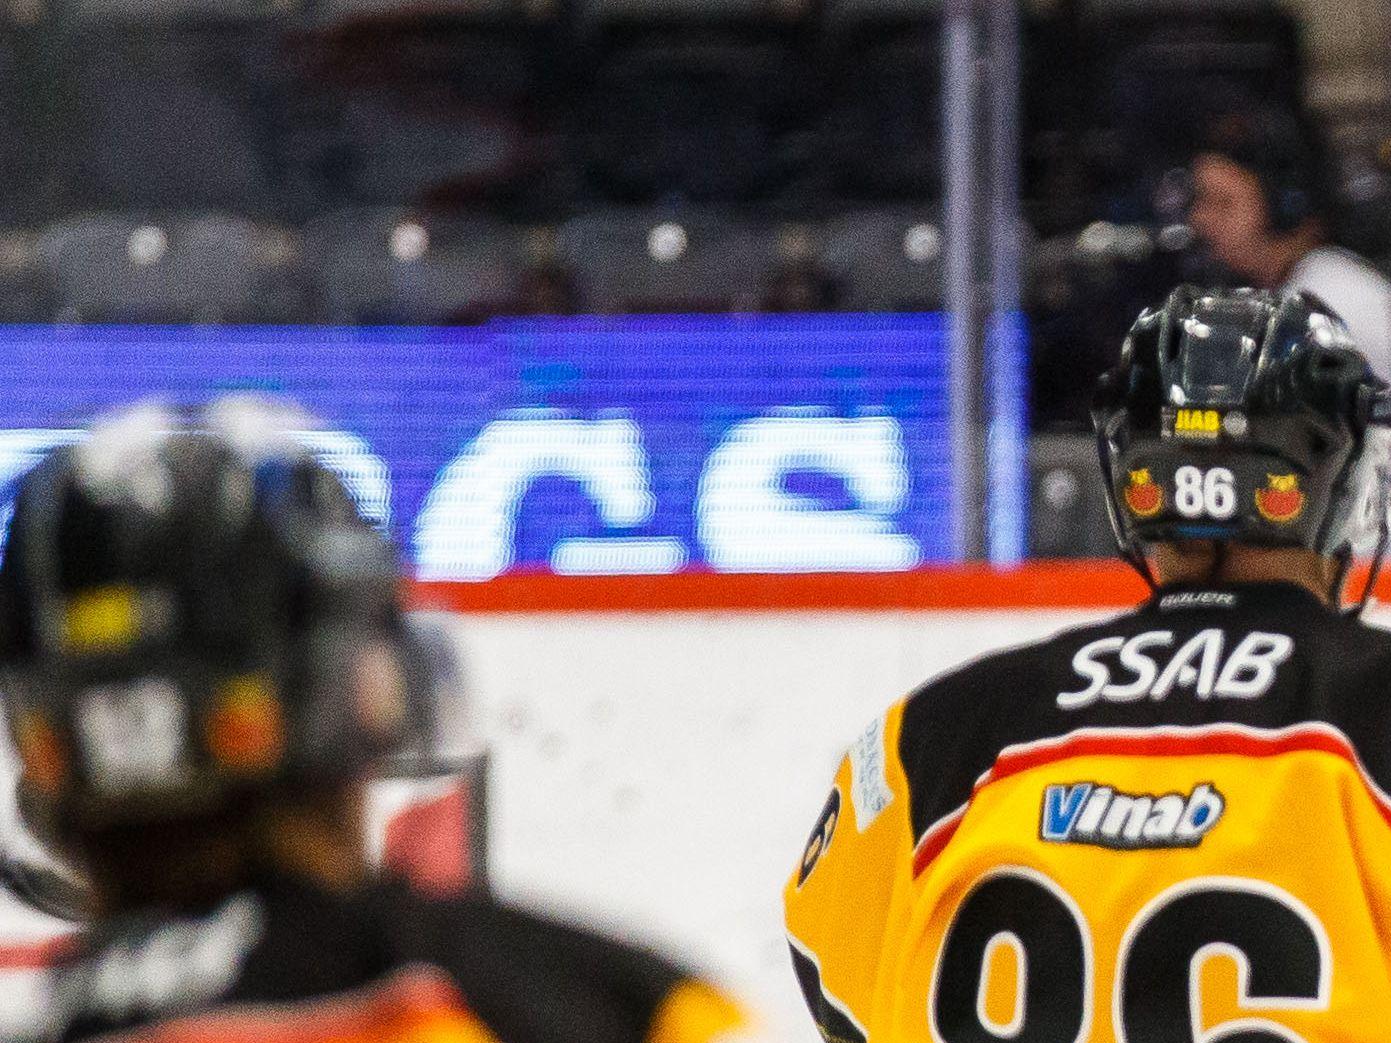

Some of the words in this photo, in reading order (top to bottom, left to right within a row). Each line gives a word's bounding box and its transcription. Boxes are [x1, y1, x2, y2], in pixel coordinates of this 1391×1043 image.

[1173, 465, 1238, 519] 86
[1056, 630, 1294, 710] SSAB
[1040, 781, 1226, 846] Vinab
